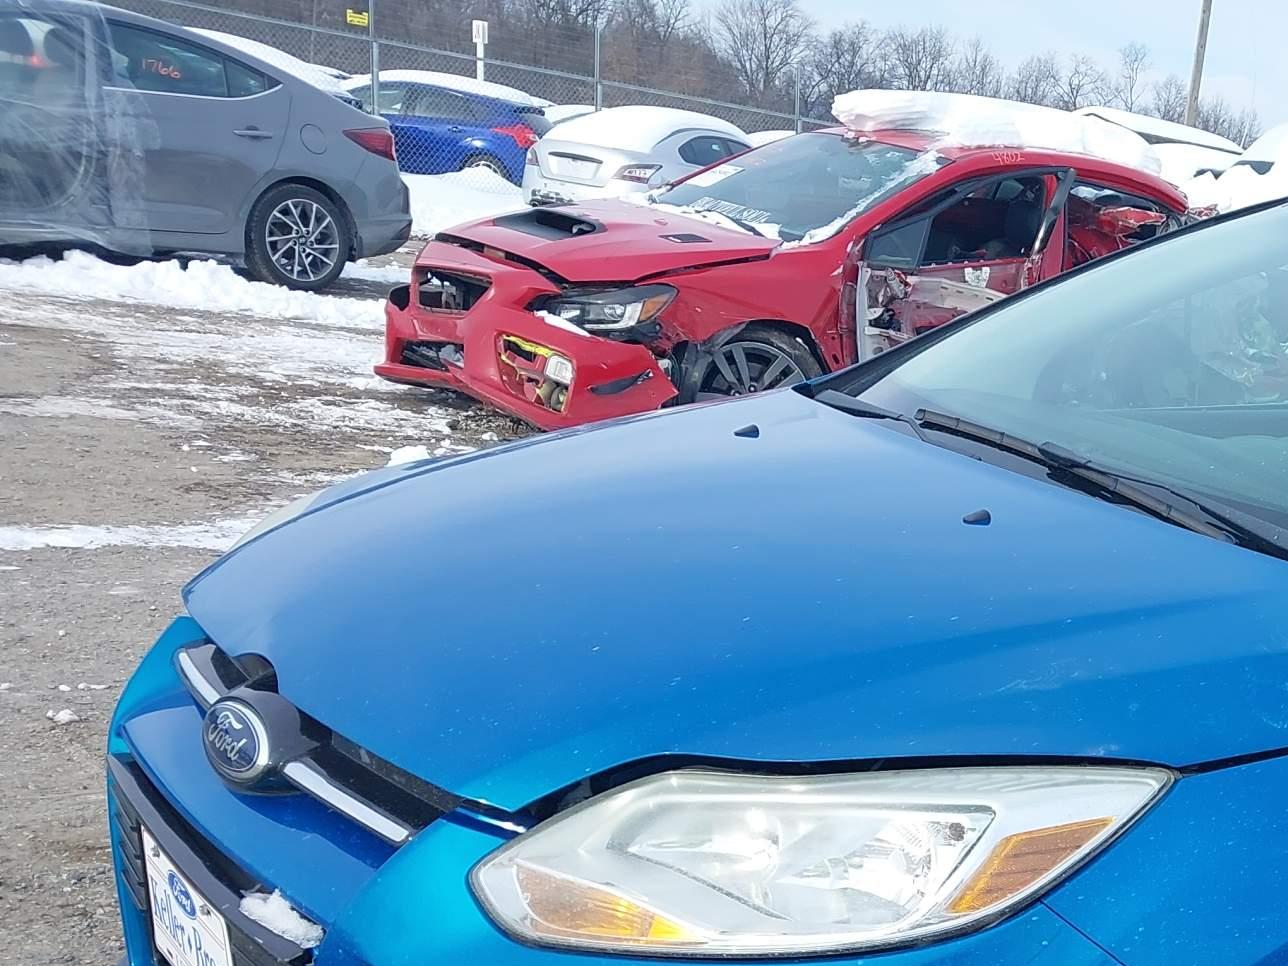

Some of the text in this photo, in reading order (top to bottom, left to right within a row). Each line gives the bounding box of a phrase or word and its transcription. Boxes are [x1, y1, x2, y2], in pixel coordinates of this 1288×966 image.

[142, 57, 182, 79] 1766
[208, 711, 247, 761] Ford
[150, 875, 186, 955] Keller
